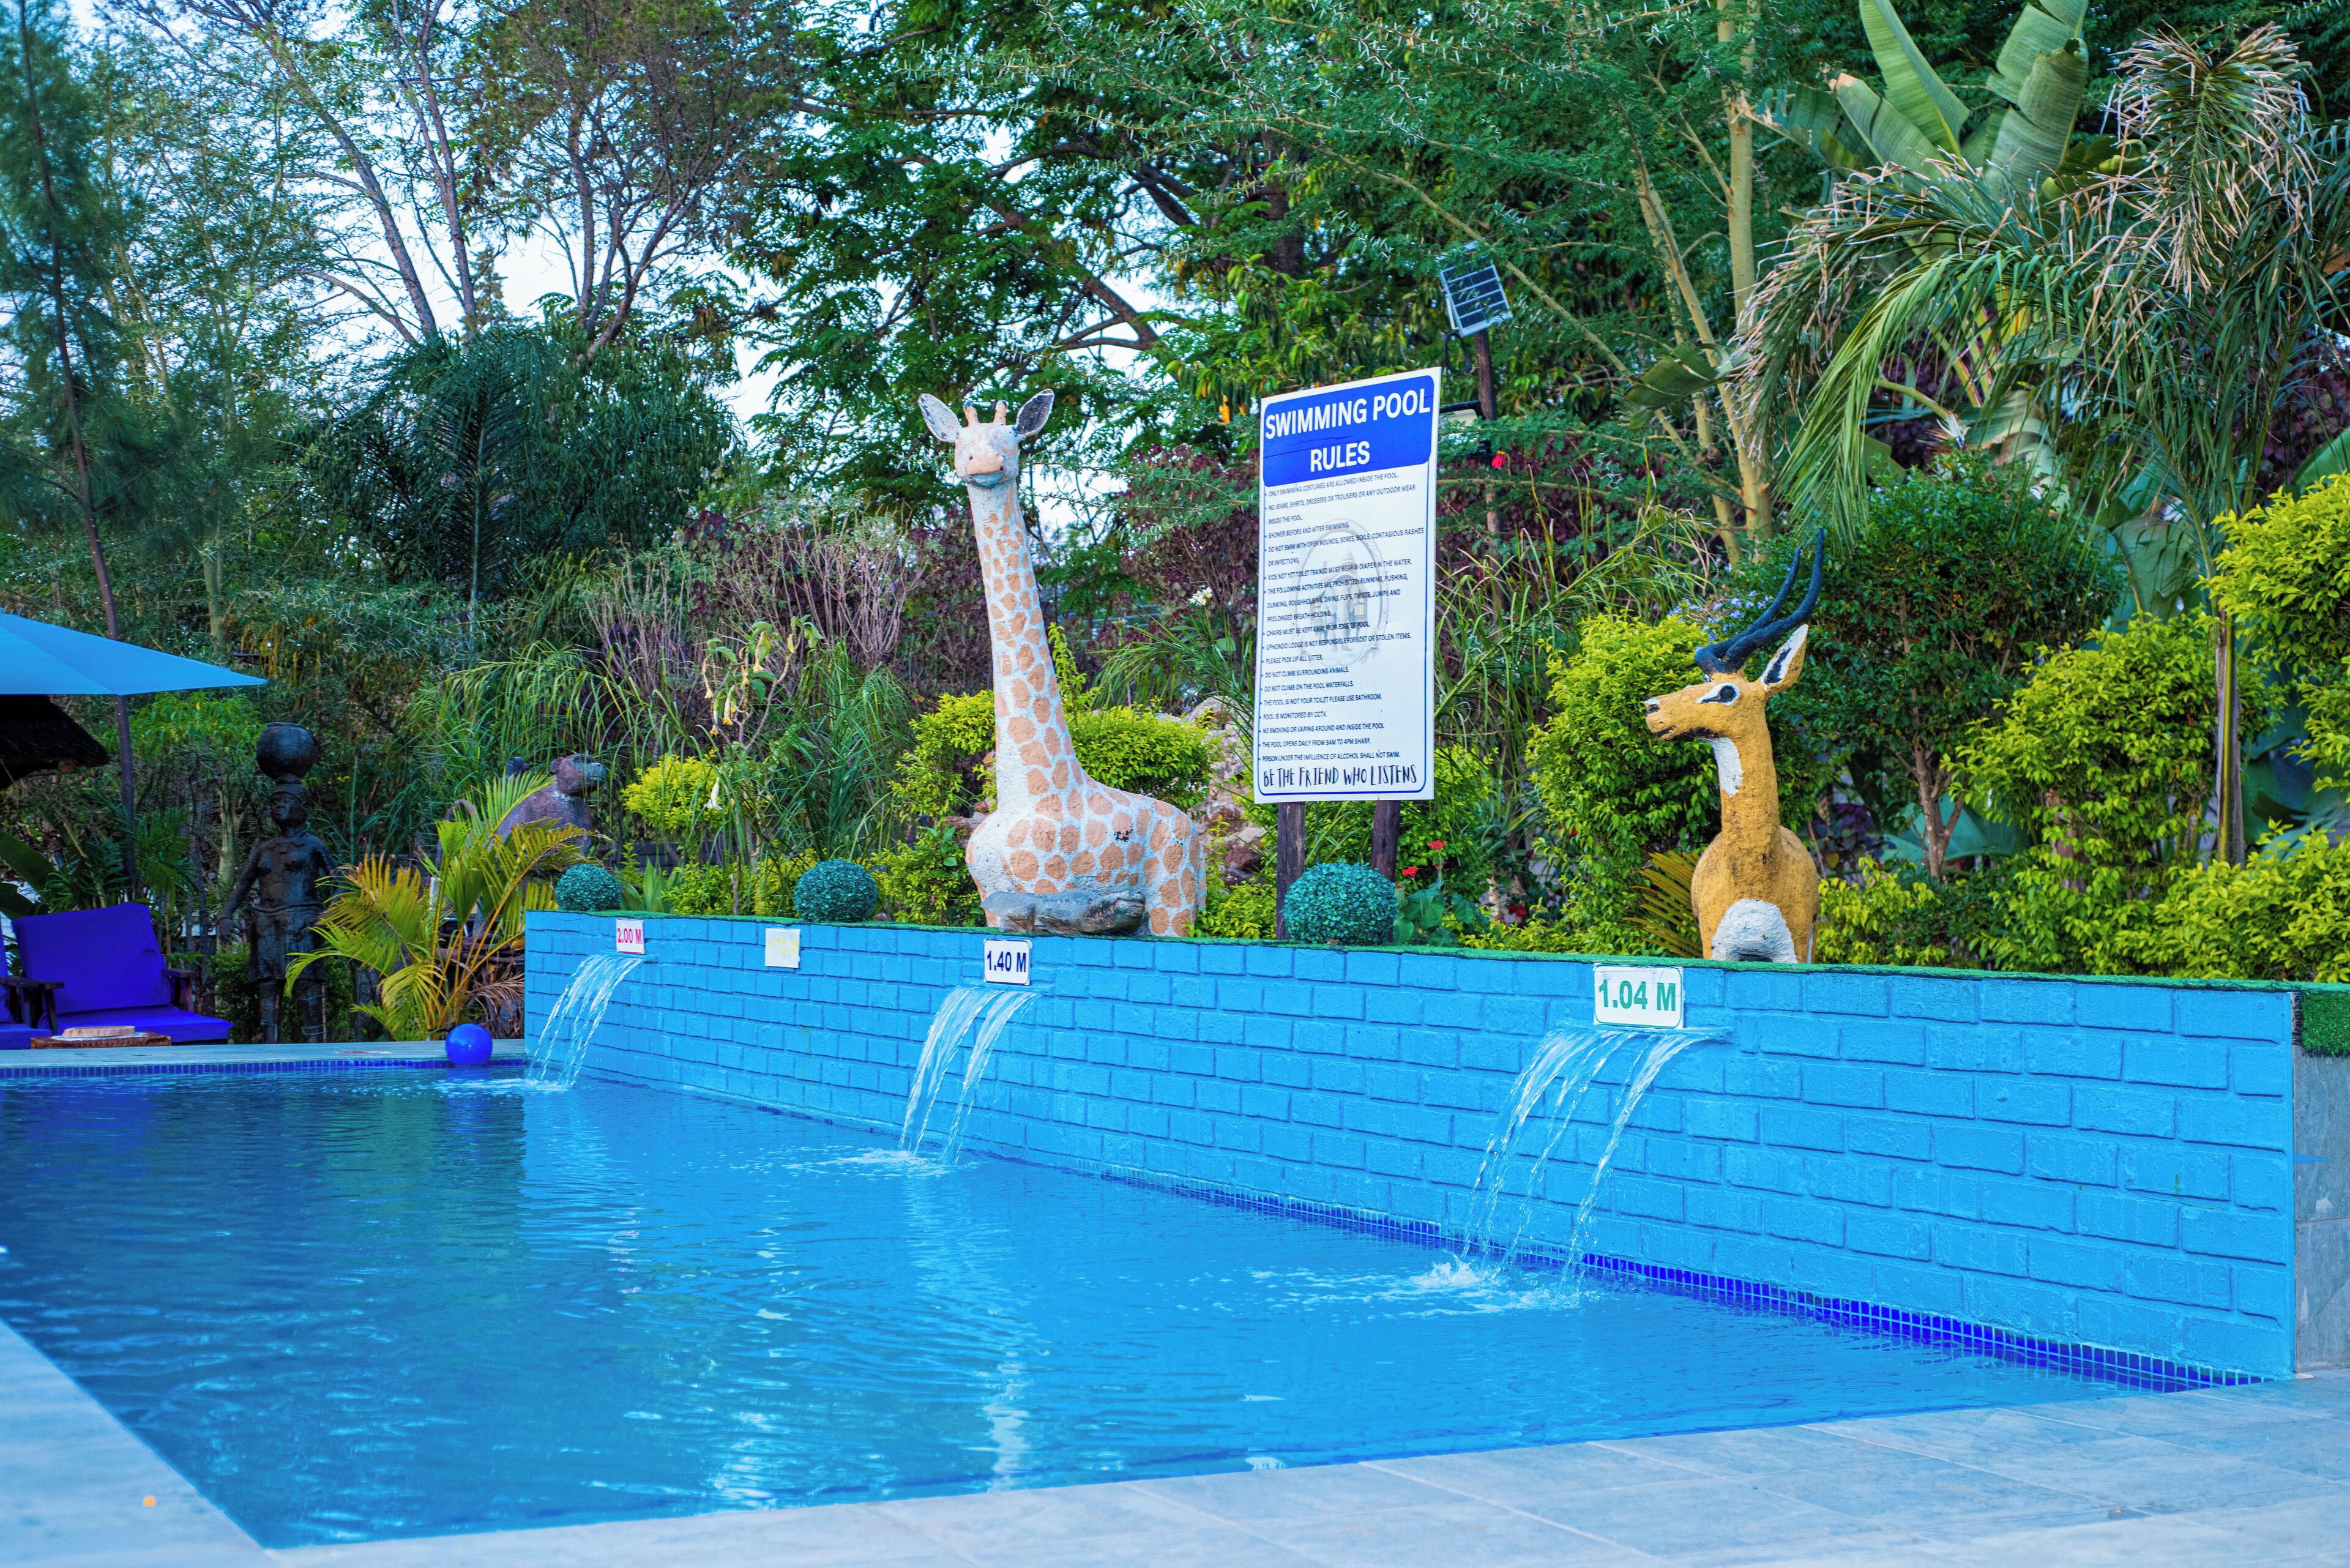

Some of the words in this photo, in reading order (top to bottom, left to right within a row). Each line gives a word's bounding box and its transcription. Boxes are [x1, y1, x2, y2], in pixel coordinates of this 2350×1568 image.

[1265, 397, 1367, 439] SWIMMING
[1373, 386, 1430, 421] POOL
[1310, 440, 1370, 472] RULES
[1280, 486, 1302, 495] SWIMMING
[1303, 483, 1325, 491] COSTUMES
[1336, 478, 1356, 487] ALLOWED
[1306, 496, 1327, 505] DRESSERS
[1335, 492, 1357, 501] TROUSERS
[1377, 486, 1400, 495] OUTDOOR
[1372, 529, 1403, 539] CONTAGIOUS
[1385, 573, 1408, 581] PUSHING,
[1264, 769, 1274, 787] BE
[1277, 767, 1295, 788] THE
[1299, 766, 1338, 787] FRIEND
[1343, 766, 1367, 786] WHO
[1371, 764, 1417, 785] LISTENS
[617, 927, 633, 944] 2.00
[635, 928, 642, 944] M
[987, 950, 1012, 972] 1.40
[1016, 952, 1026, 973] M
[1599, 979, 1648, 1009] 1.04
[1657, 982, 1676, 1012] M
